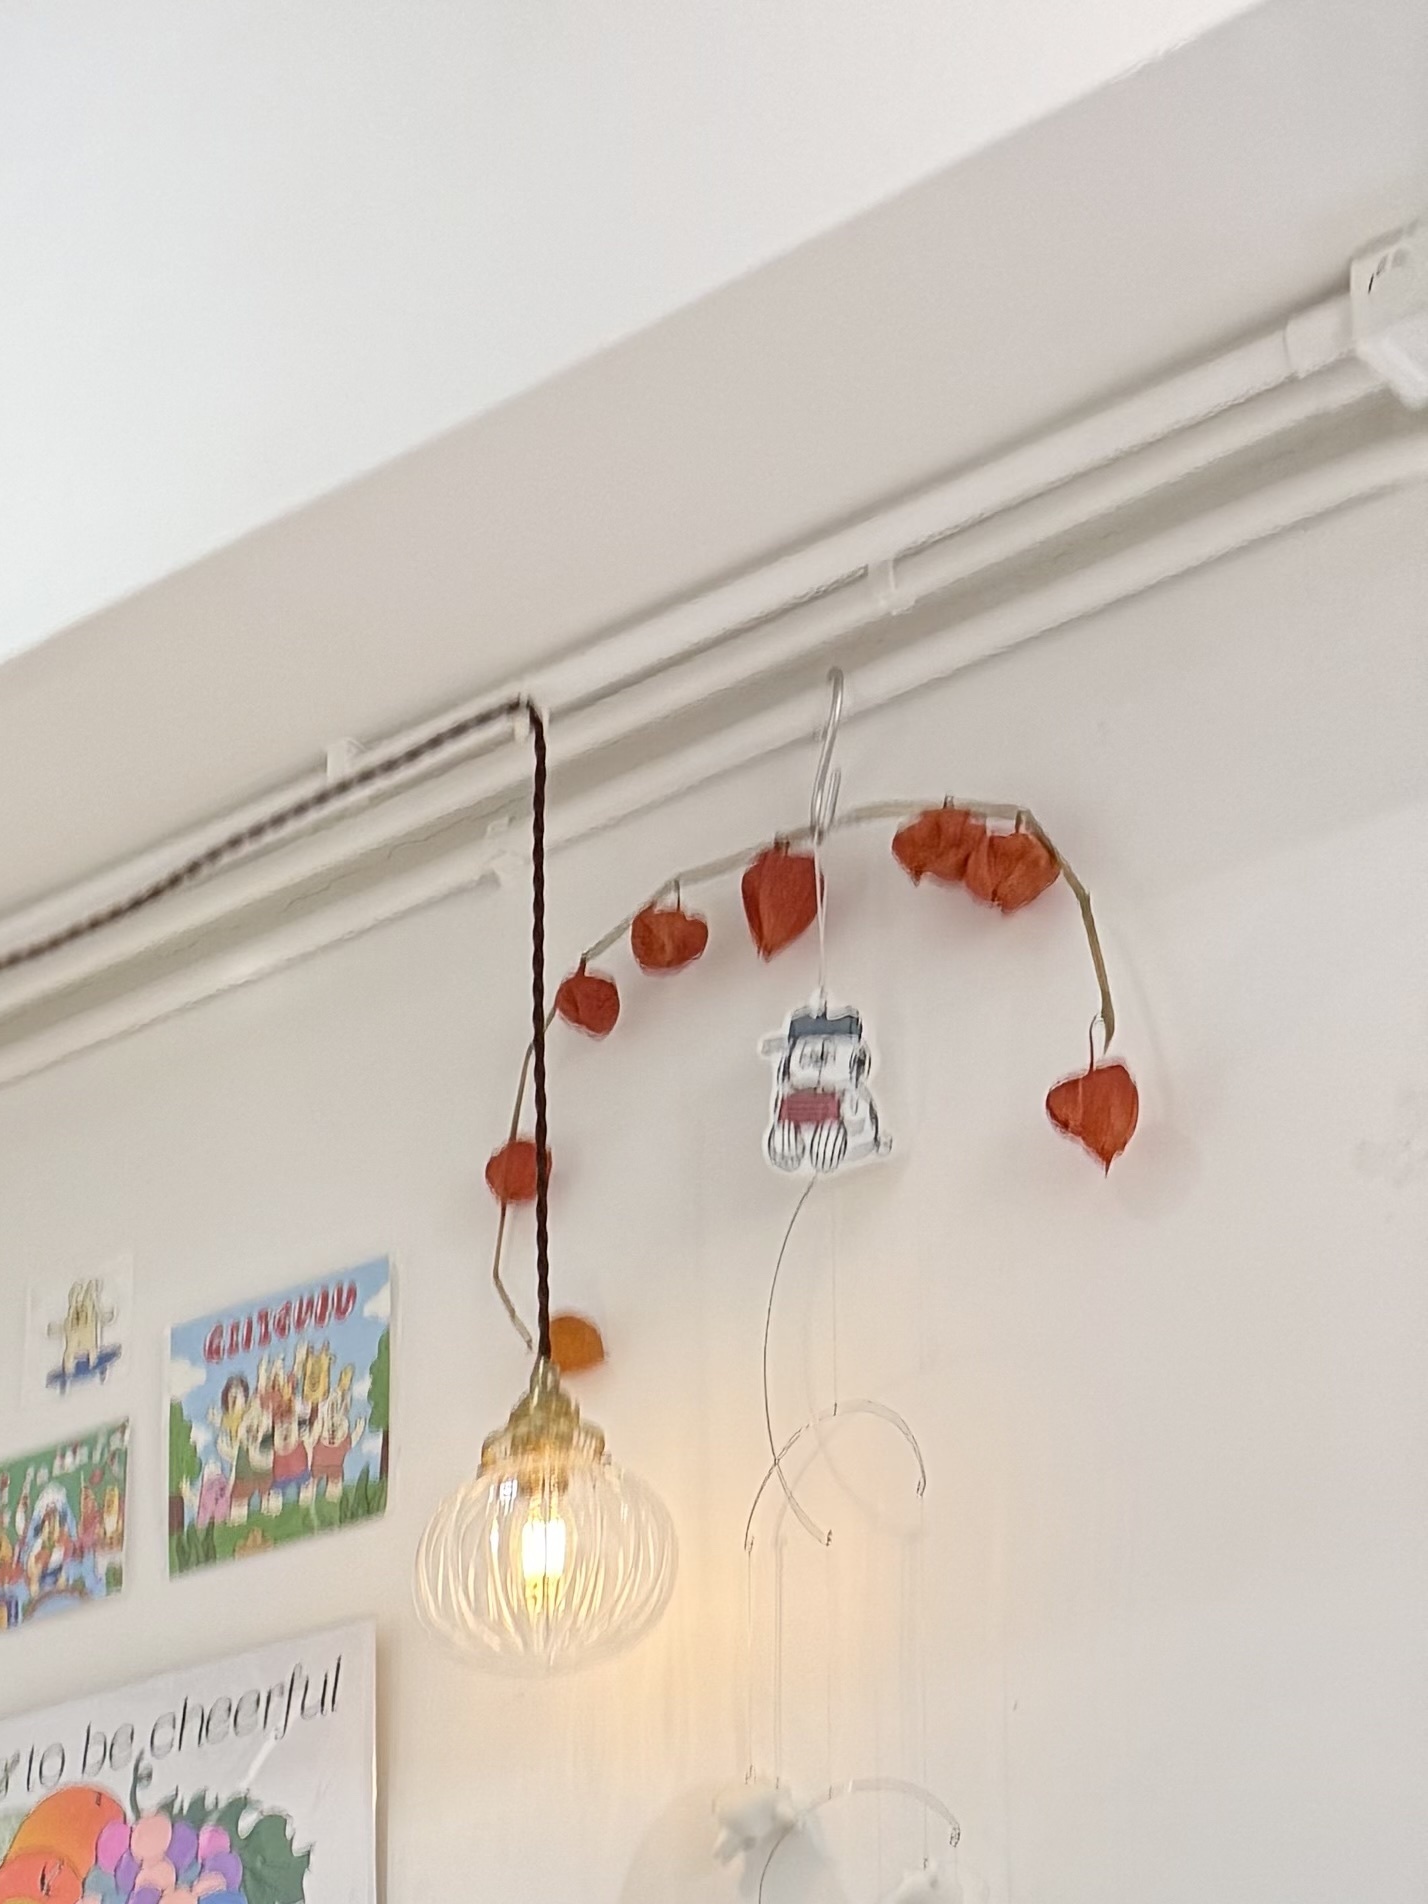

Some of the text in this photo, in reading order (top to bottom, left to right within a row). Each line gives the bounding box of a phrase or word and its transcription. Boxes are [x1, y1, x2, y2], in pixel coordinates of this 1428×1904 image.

[25, 1742, 66, 1792] to
[81, 1721, 135, 1777] be
[150, 1655, 342, 1760] cheerful
